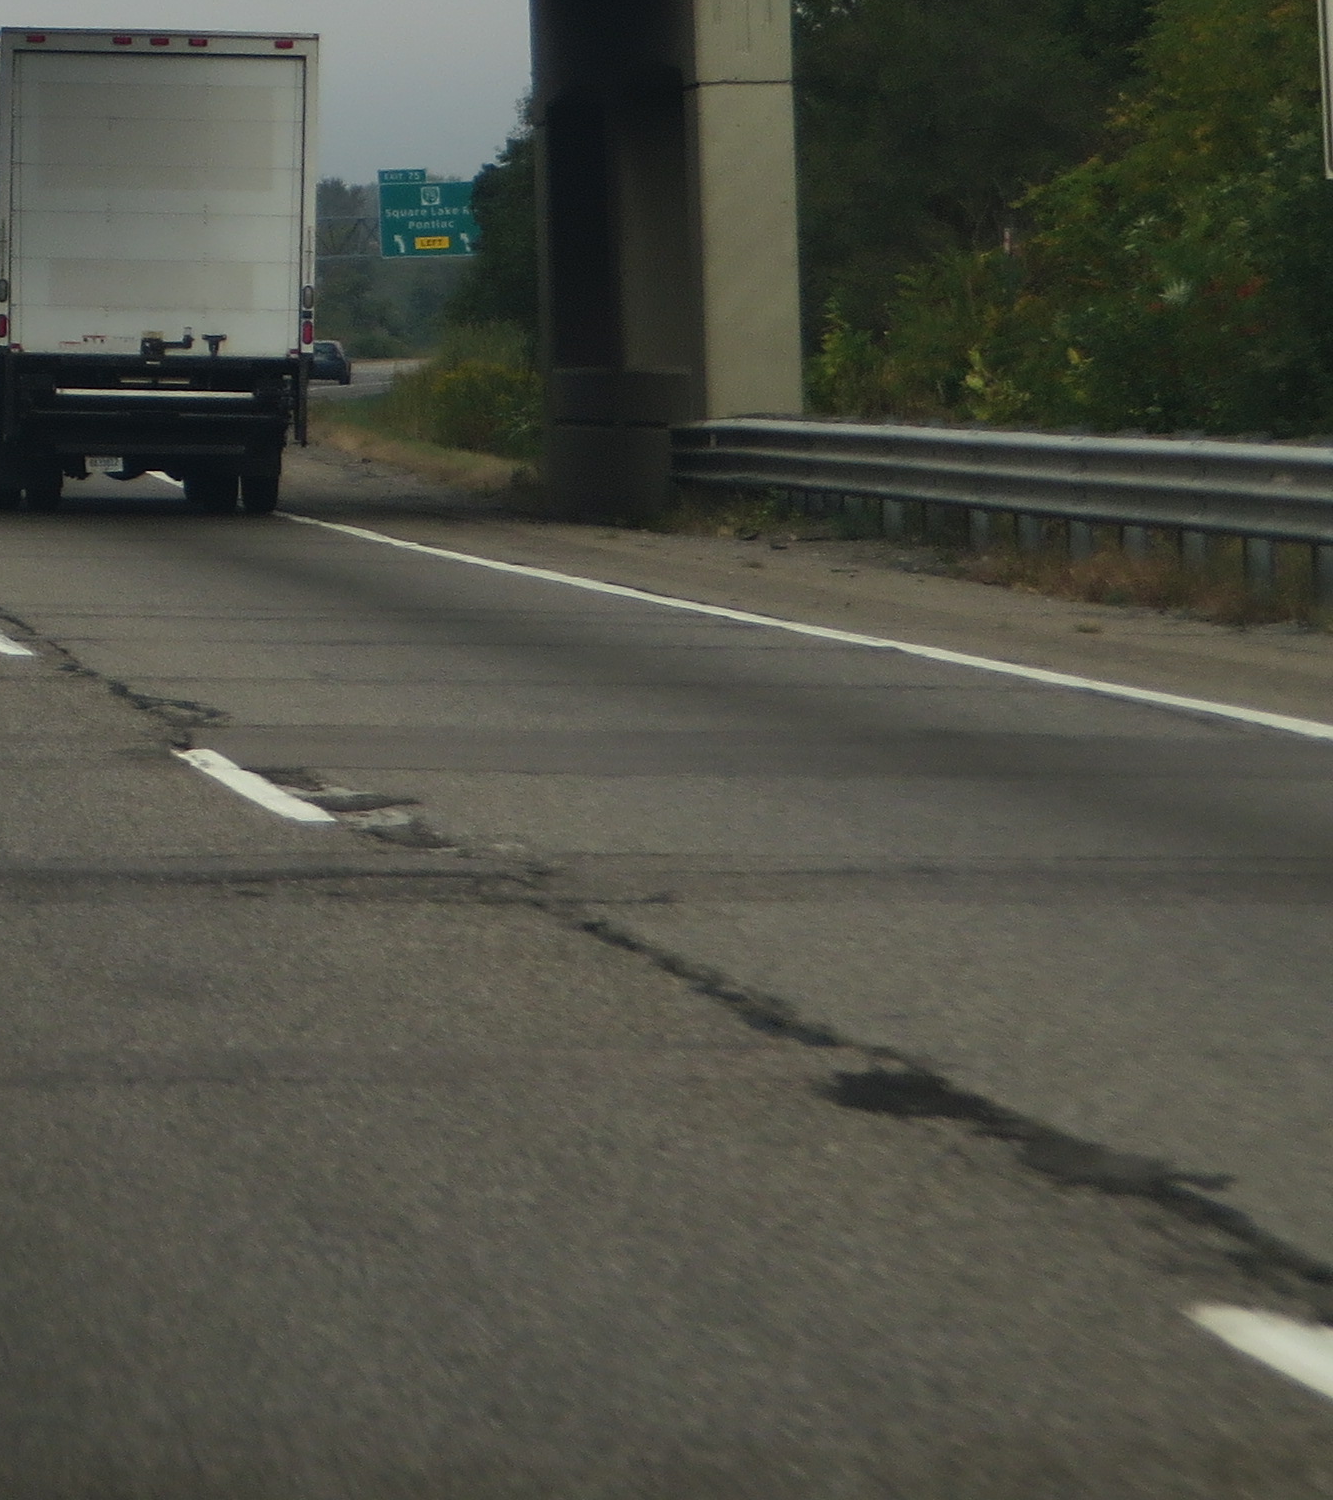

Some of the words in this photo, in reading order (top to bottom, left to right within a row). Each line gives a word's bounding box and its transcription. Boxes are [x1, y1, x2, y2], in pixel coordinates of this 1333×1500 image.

[385, 208, 427, 218] Square
[431, 206, 459, 216] Lake
[408, 220, 454, 230] Pontiac
[420, 239, 444, 247] LEFT
